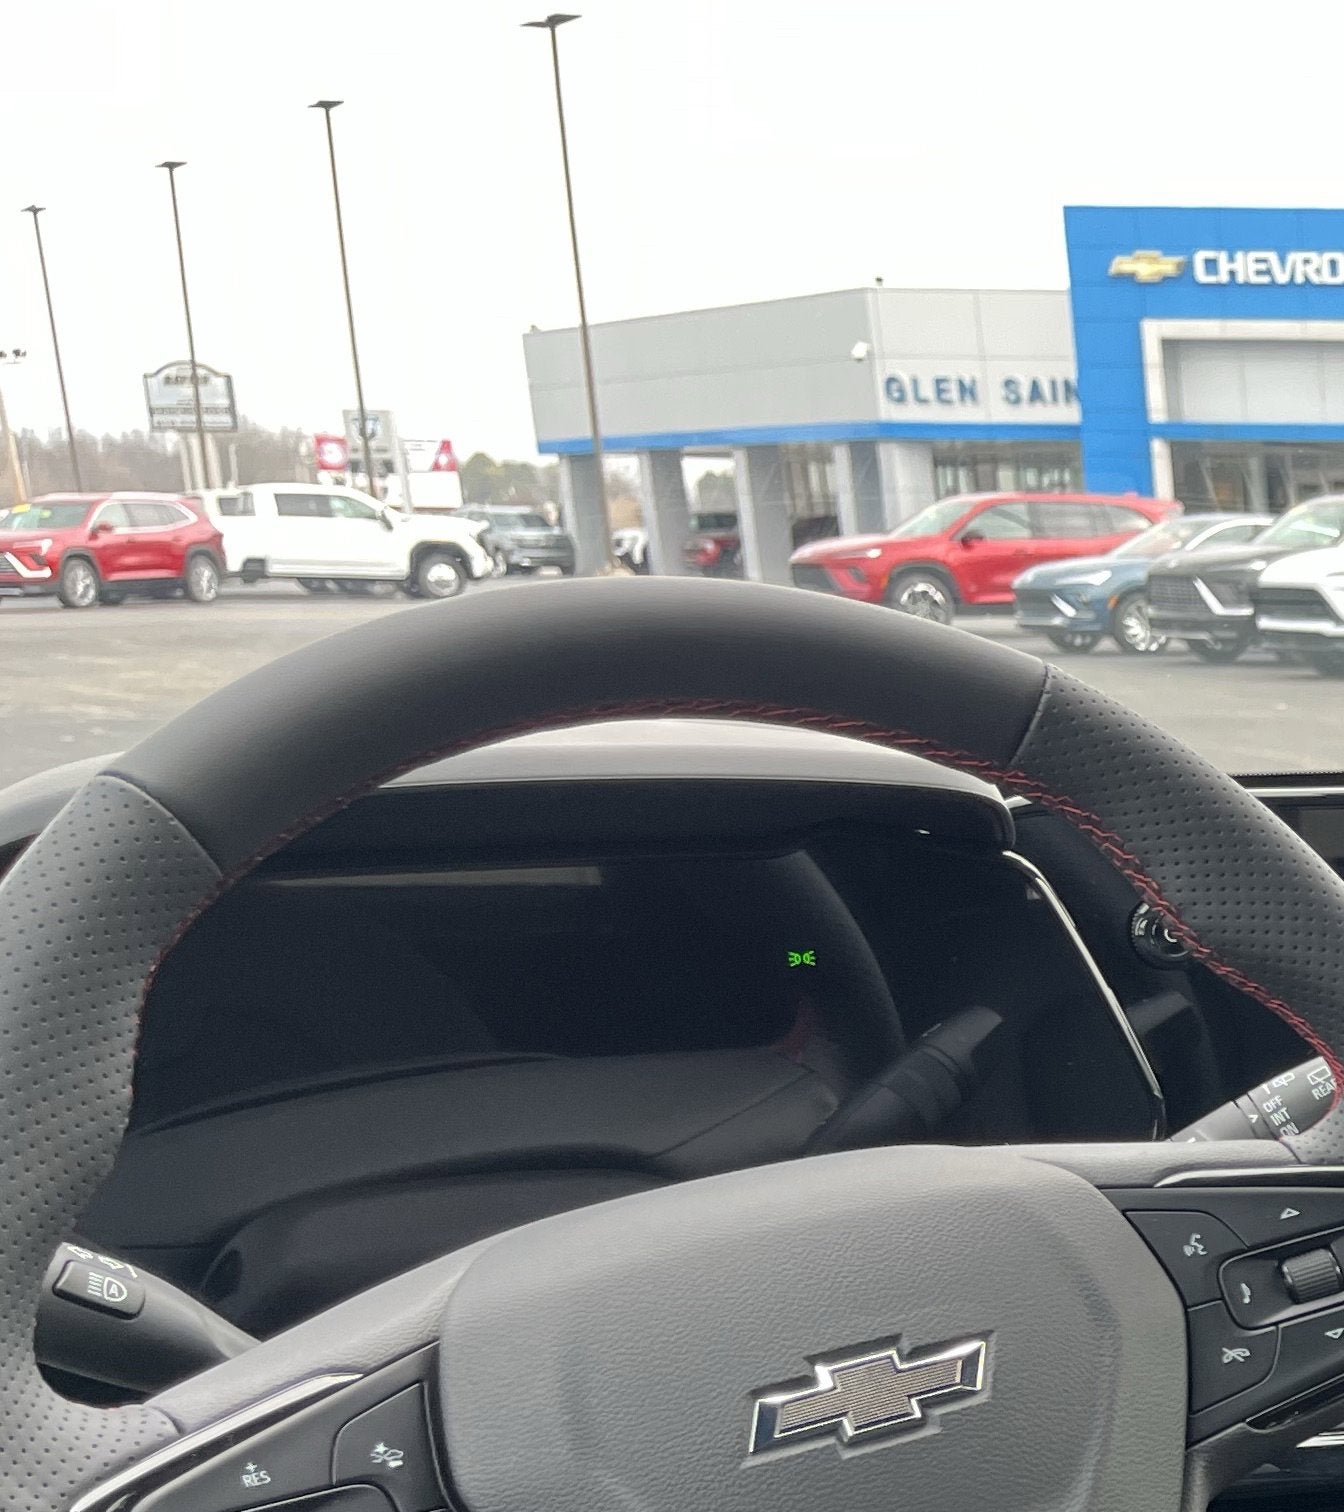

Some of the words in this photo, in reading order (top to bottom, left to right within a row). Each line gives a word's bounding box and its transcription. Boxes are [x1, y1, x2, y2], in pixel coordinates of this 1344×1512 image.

[885, 376, 978, 404] GLEN
[1002, 376, 1080, 405] SAIN
[1263, 1095, 1283, 1113] OFF
[1270, 1107, 1291, 1126] INT
[1279, 1121, 1300, 1136] ON
[241, 1470, 272, 1488] RES
